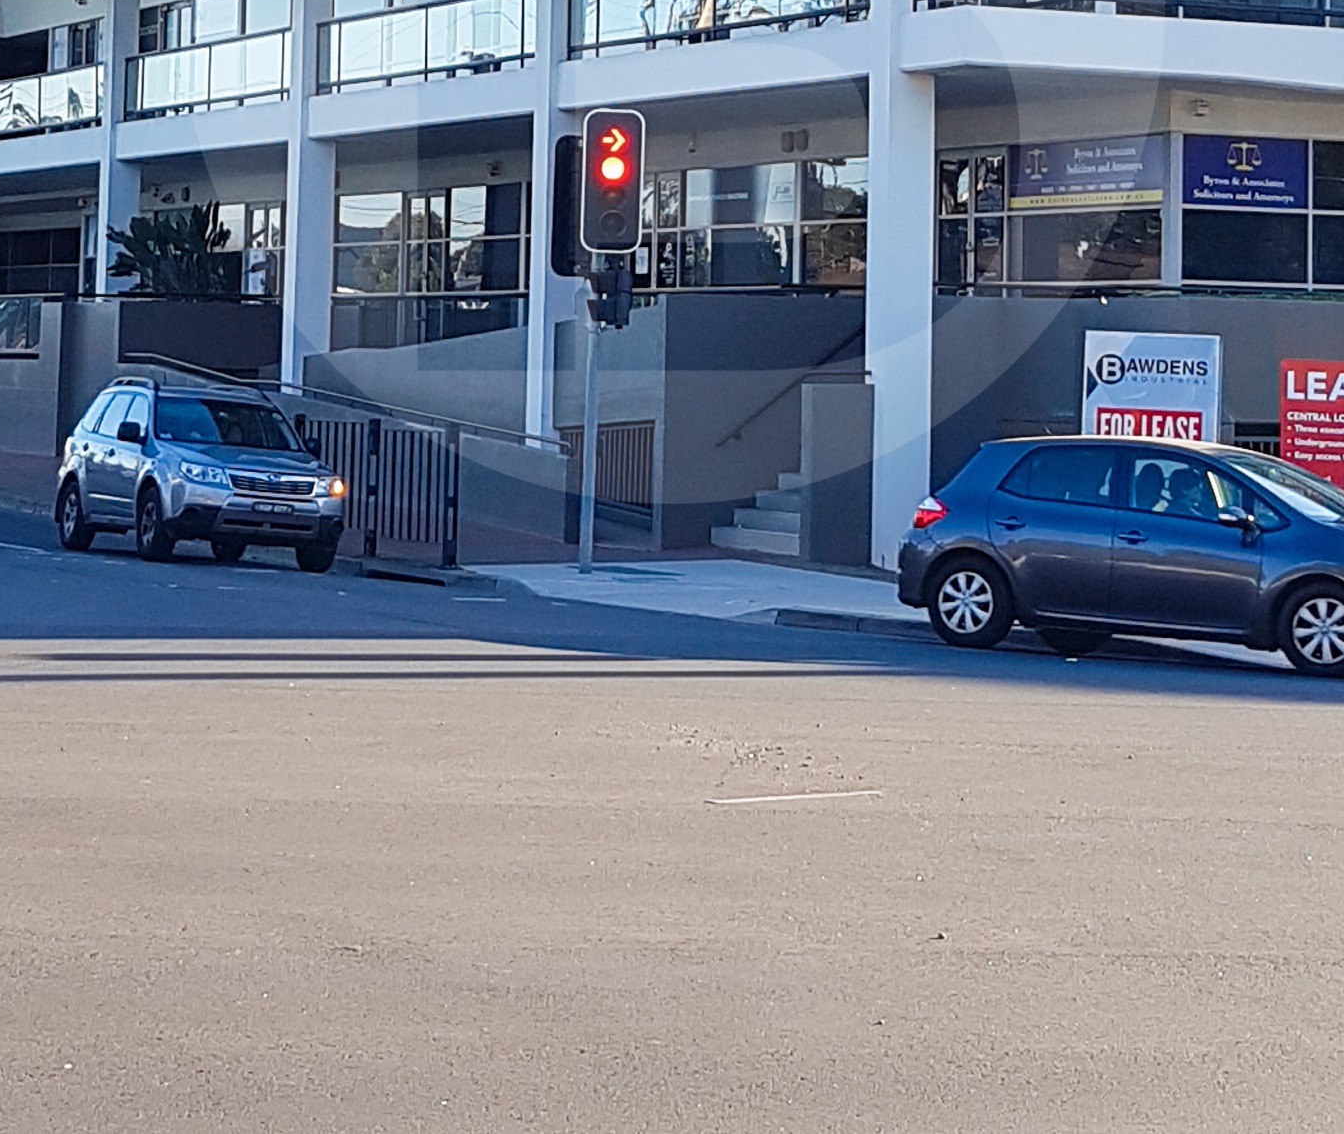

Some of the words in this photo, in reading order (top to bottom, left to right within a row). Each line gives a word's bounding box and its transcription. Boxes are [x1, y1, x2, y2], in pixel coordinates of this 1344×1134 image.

[1097, 355, 1209, 383] BAWDENS
[1100, 412, 1136, 436] FOR
[1141, 414, 1200, 440] LEASE
[1286, 411, 1331, 423] CENTRAL
